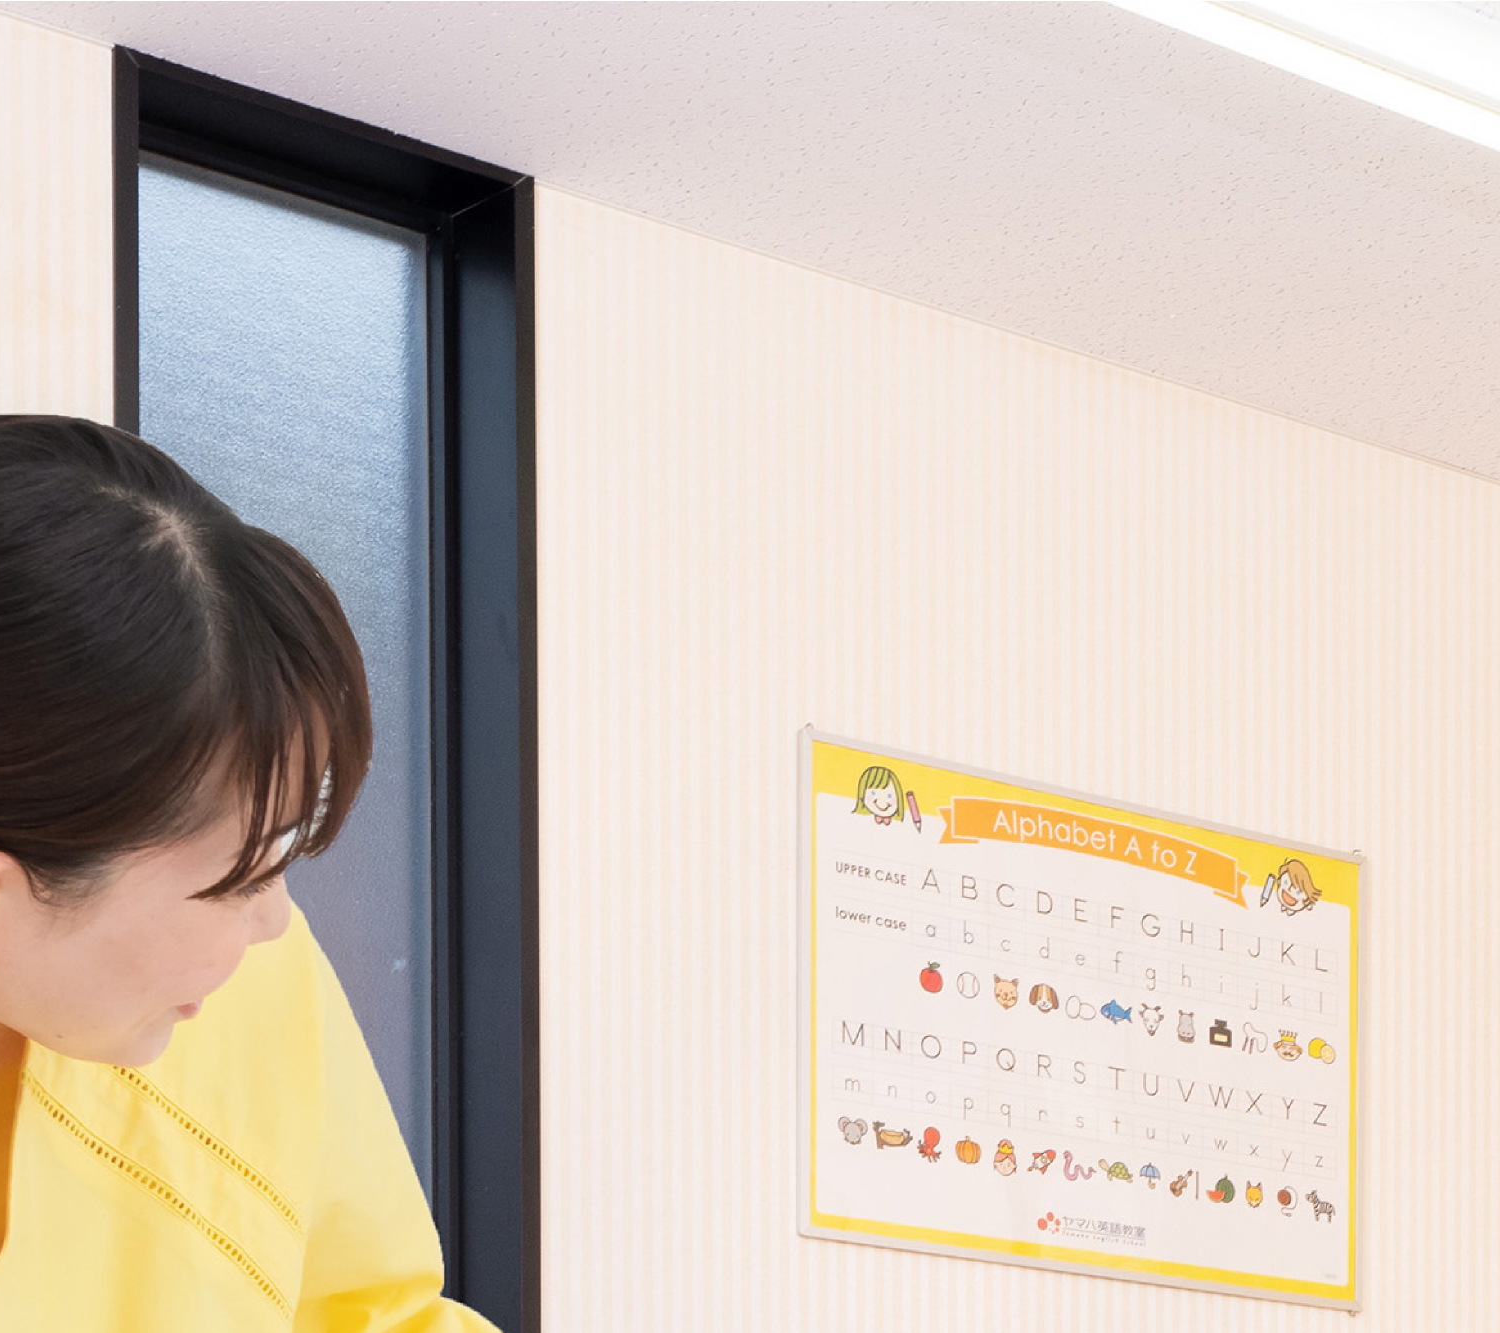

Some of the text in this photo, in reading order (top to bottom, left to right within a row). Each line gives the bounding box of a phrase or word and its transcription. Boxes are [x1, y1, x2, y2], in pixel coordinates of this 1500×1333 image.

[835, 861, 907, 886] UPPER CASE
[993, 810, 1197, 876] Alphabet A to Z
[835, 906, 907, 931] lower case
[921, 868, 940, 893] A
[961, 875, 978, 900] B
[996, 883, 1015, 908] C
[1036, 890, 1053, 915] D
[1074, 898, 1088, 923] E
[1111, 906, 1124, 928] F
[1140, 913, 1161, 937] G
[1180, 920, 1194, 944] H
[1248, 937, 1261, 958] J
[1281, 941, 1295, 965] K
[1315, 949, 1328, 972] L
[925, 923, 936, 937] a
[963, 920, 974, 944] b
[1001, 939, 1011, 952] c
[1039, 937, 1050, 959] d
[1075, 954, 1086, 966] e
[1113, 951, 1124, 974] f
[1145, 967, 1156, 991] g
[1181, 964, 1191, 987] h
[1250, 982, 1259, 1011] j
[1281, 984, 1292, 1007] k
[841, 1020, 1327, 1126] M N O P Q R S T U V W X Y Z
[844, 1078, 861, 1092] m
[887, 1084, 897, 1098] n
[963, 1097, 974, 1120] p
[1001, 1103, 1011, 1127] q
[1038, 1108, 1048, 1122] r
[1113, 1116, 1121, 1133] t
[1146, 1127, 1155, 1140] u
[1281, 1150, 1293, 1172] y
